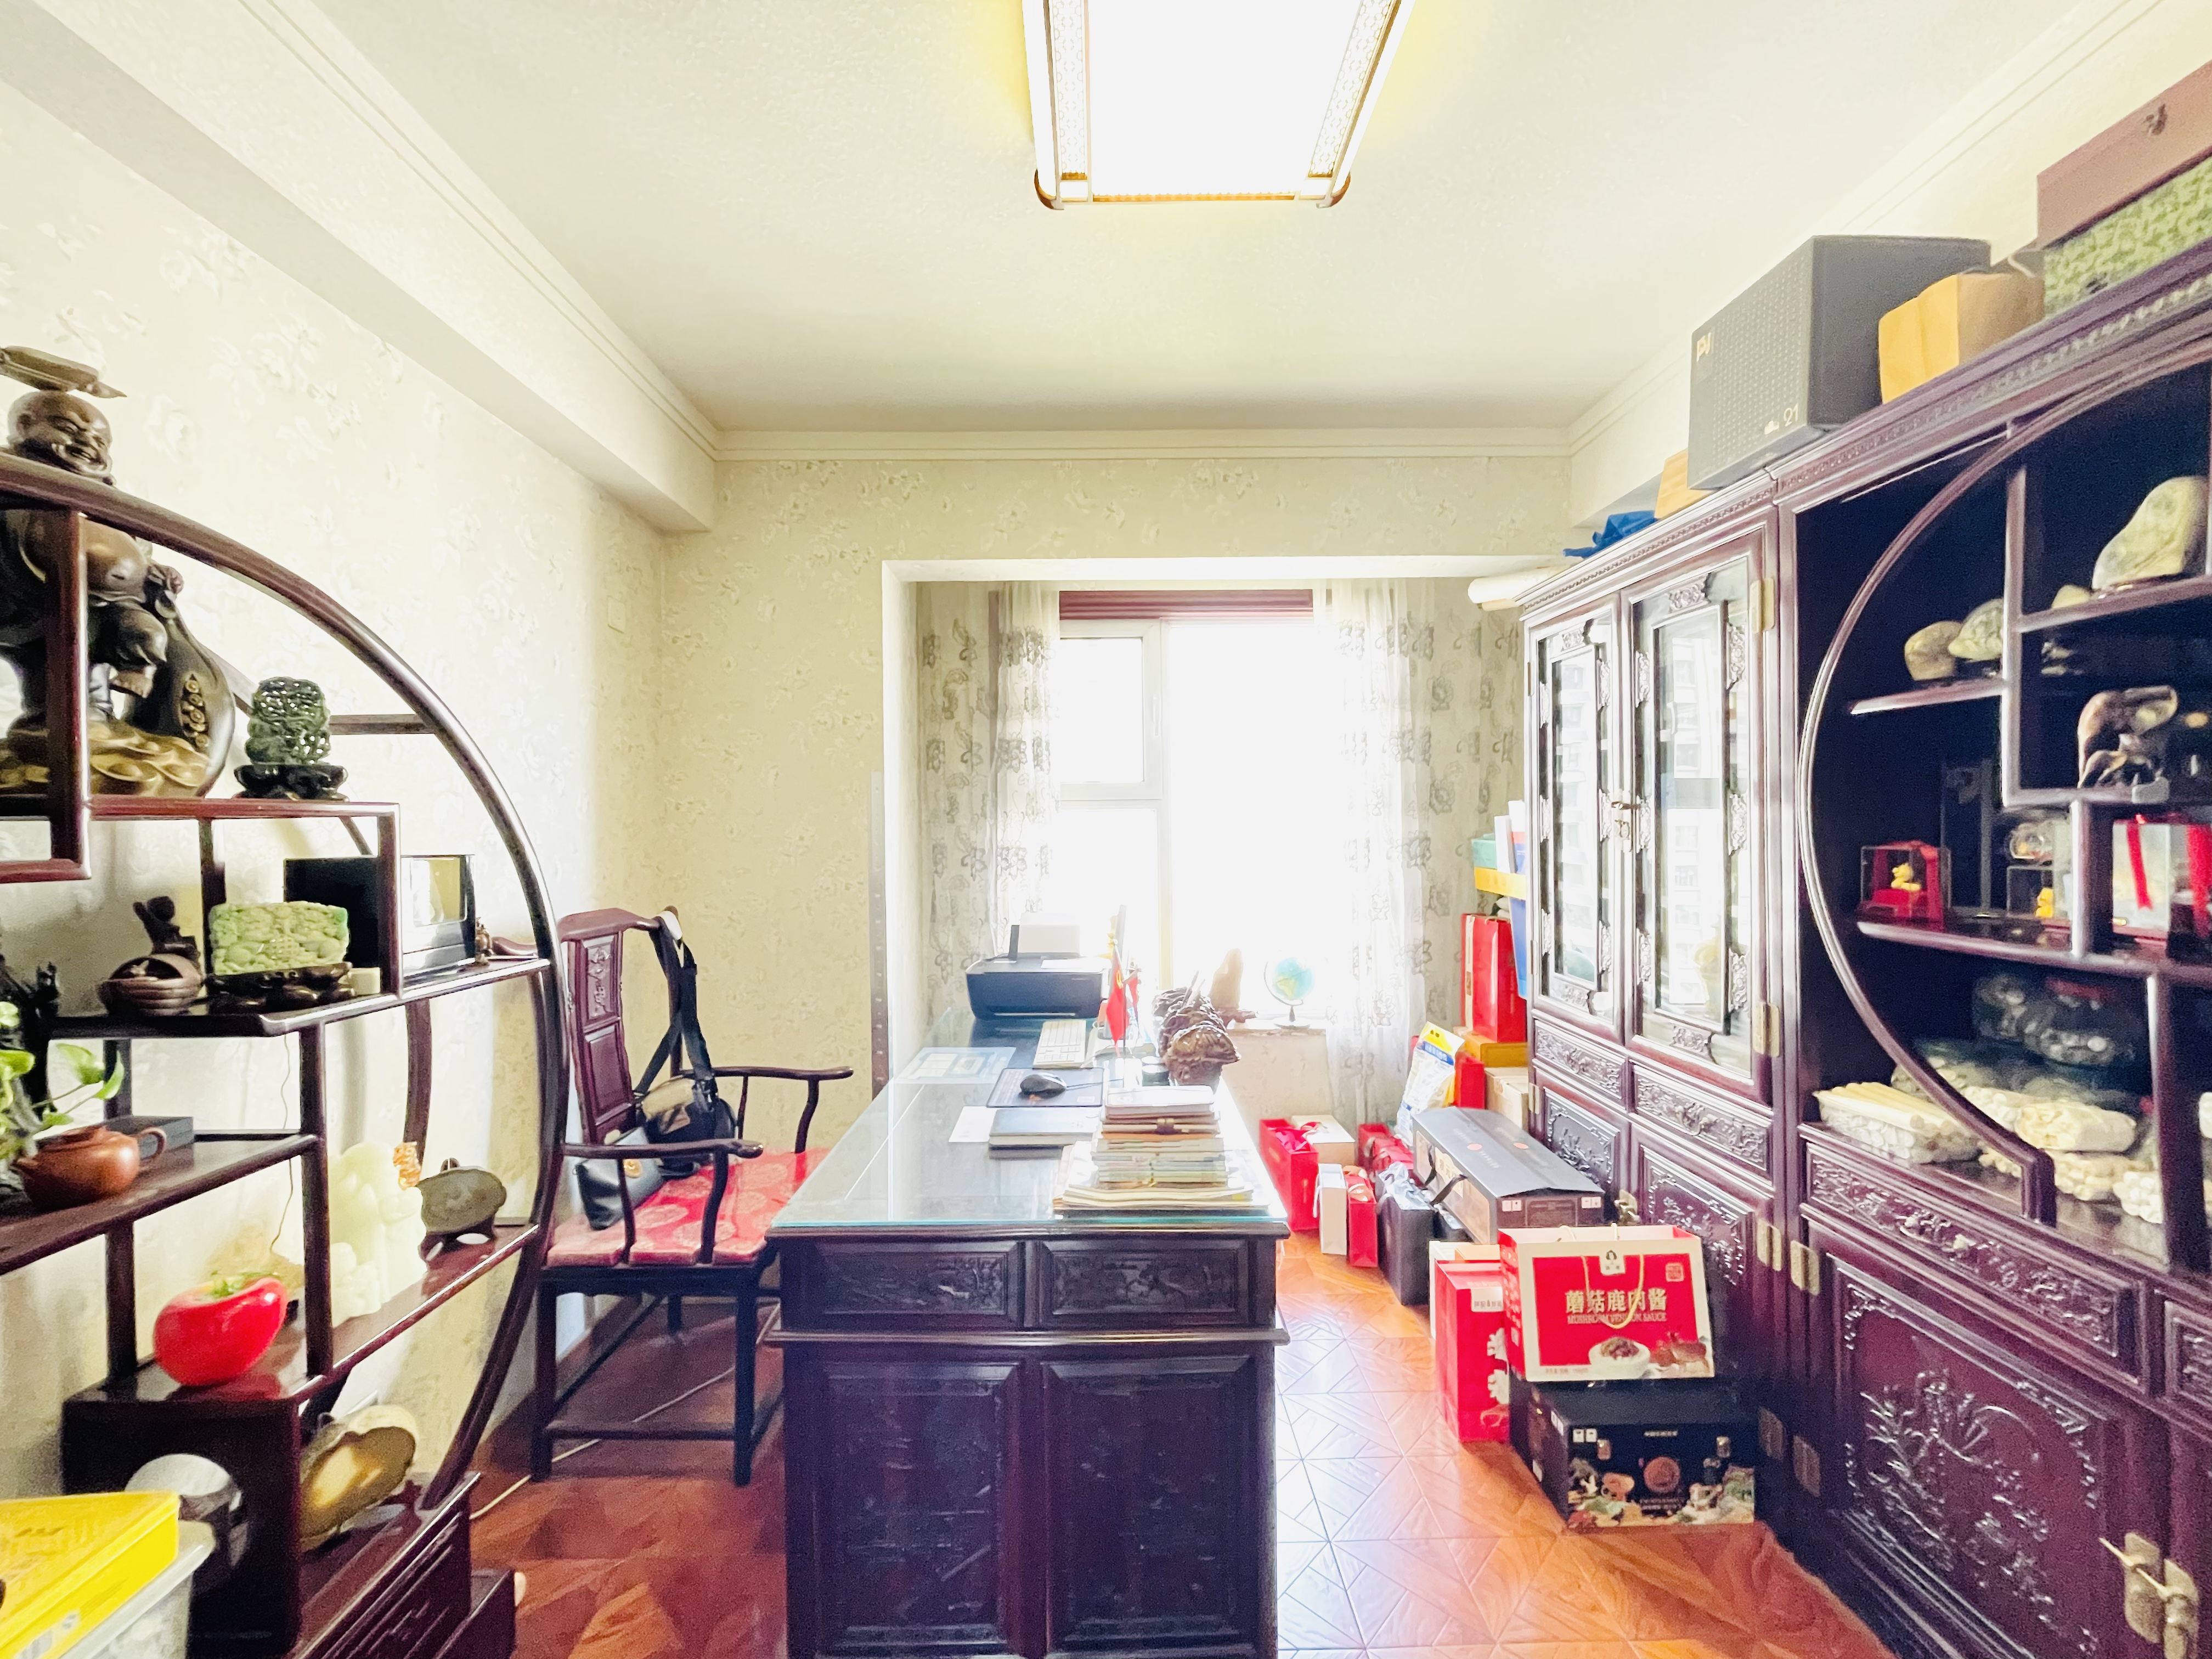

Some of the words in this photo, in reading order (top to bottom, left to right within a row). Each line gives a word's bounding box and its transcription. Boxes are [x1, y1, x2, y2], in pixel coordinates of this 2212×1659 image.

[1783, 403, 1799, 427] 21
[1565, 1288, 1667, 1314] 蘑菇鹿肉酱
